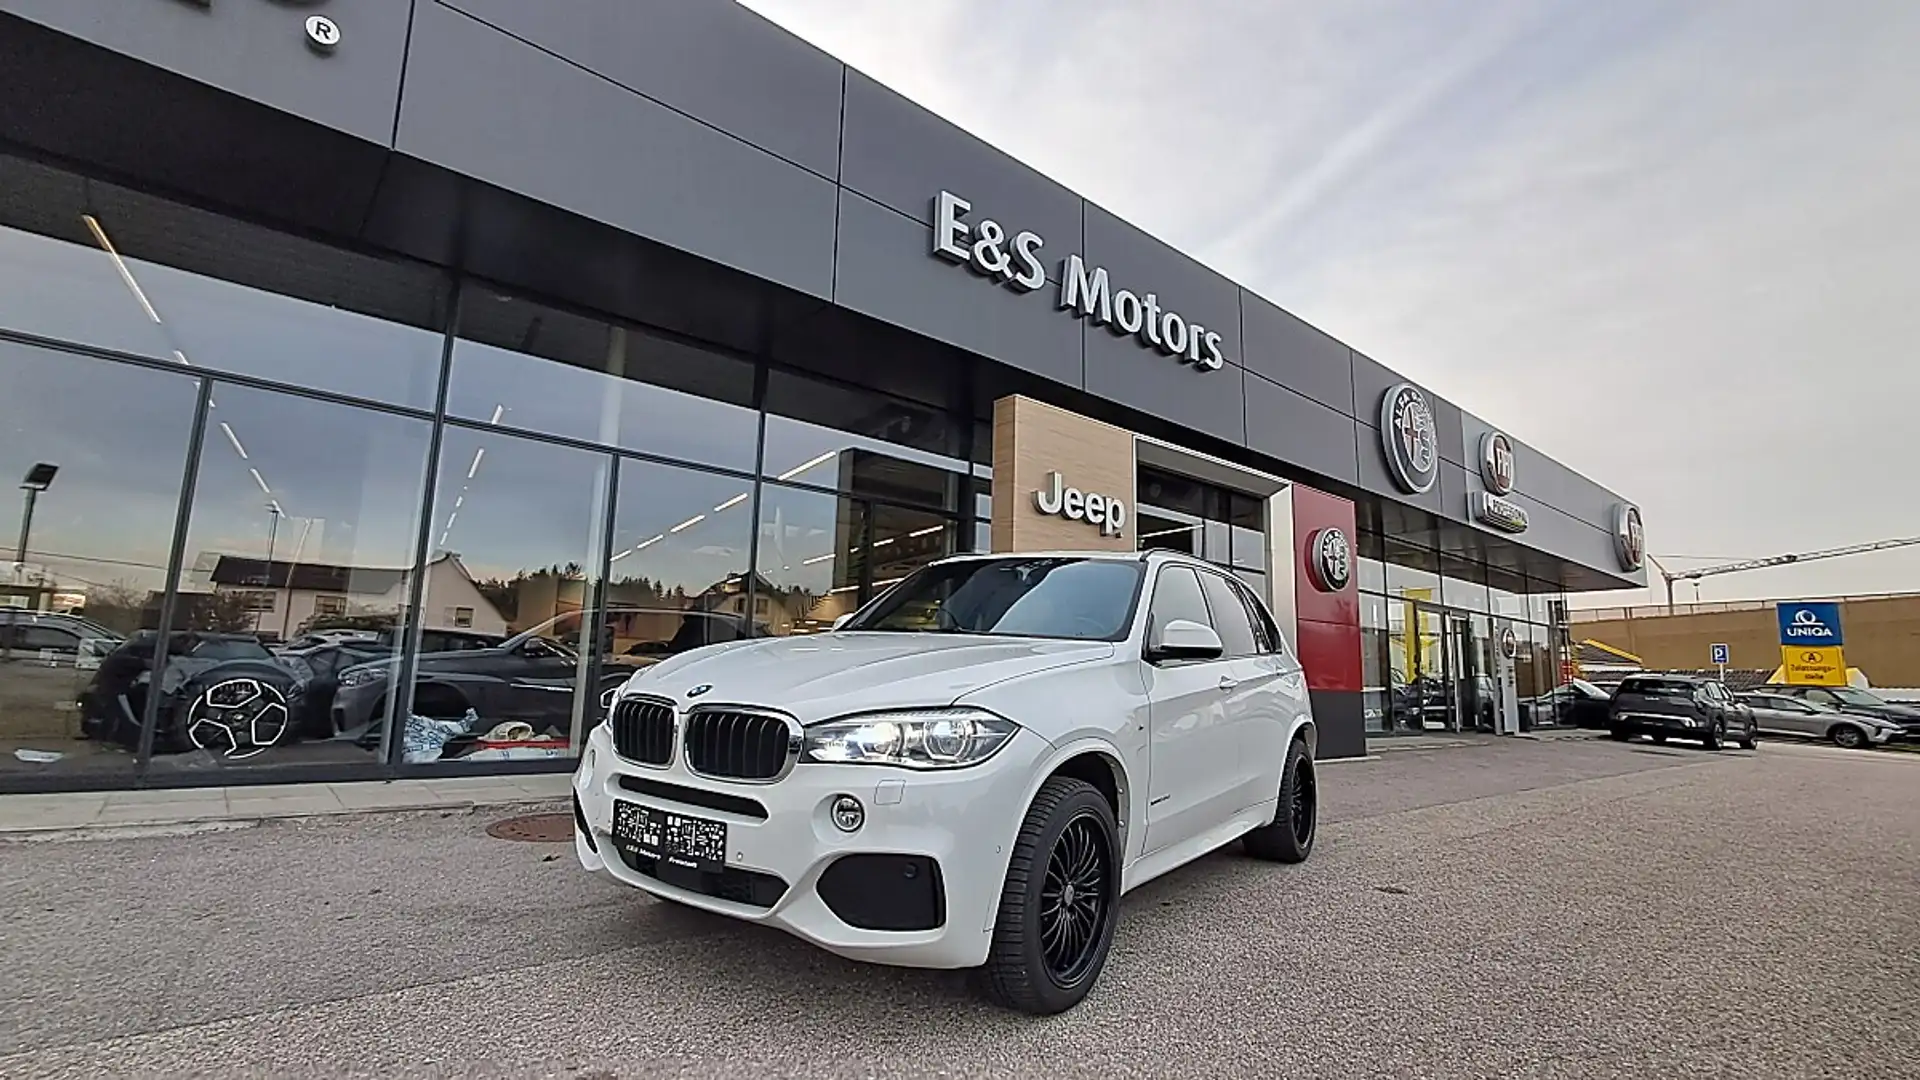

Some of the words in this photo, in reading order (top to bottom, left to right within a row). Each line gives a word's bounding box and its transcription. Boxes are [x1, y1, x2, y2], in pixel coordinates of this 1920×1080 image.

[934, 190, 1046, 290] E&S
[1061, 253, 1224, 371] Motors
[1034, 470, 1126, 536] Jeep
[1787, 627, 1833, 637] UNIQA
